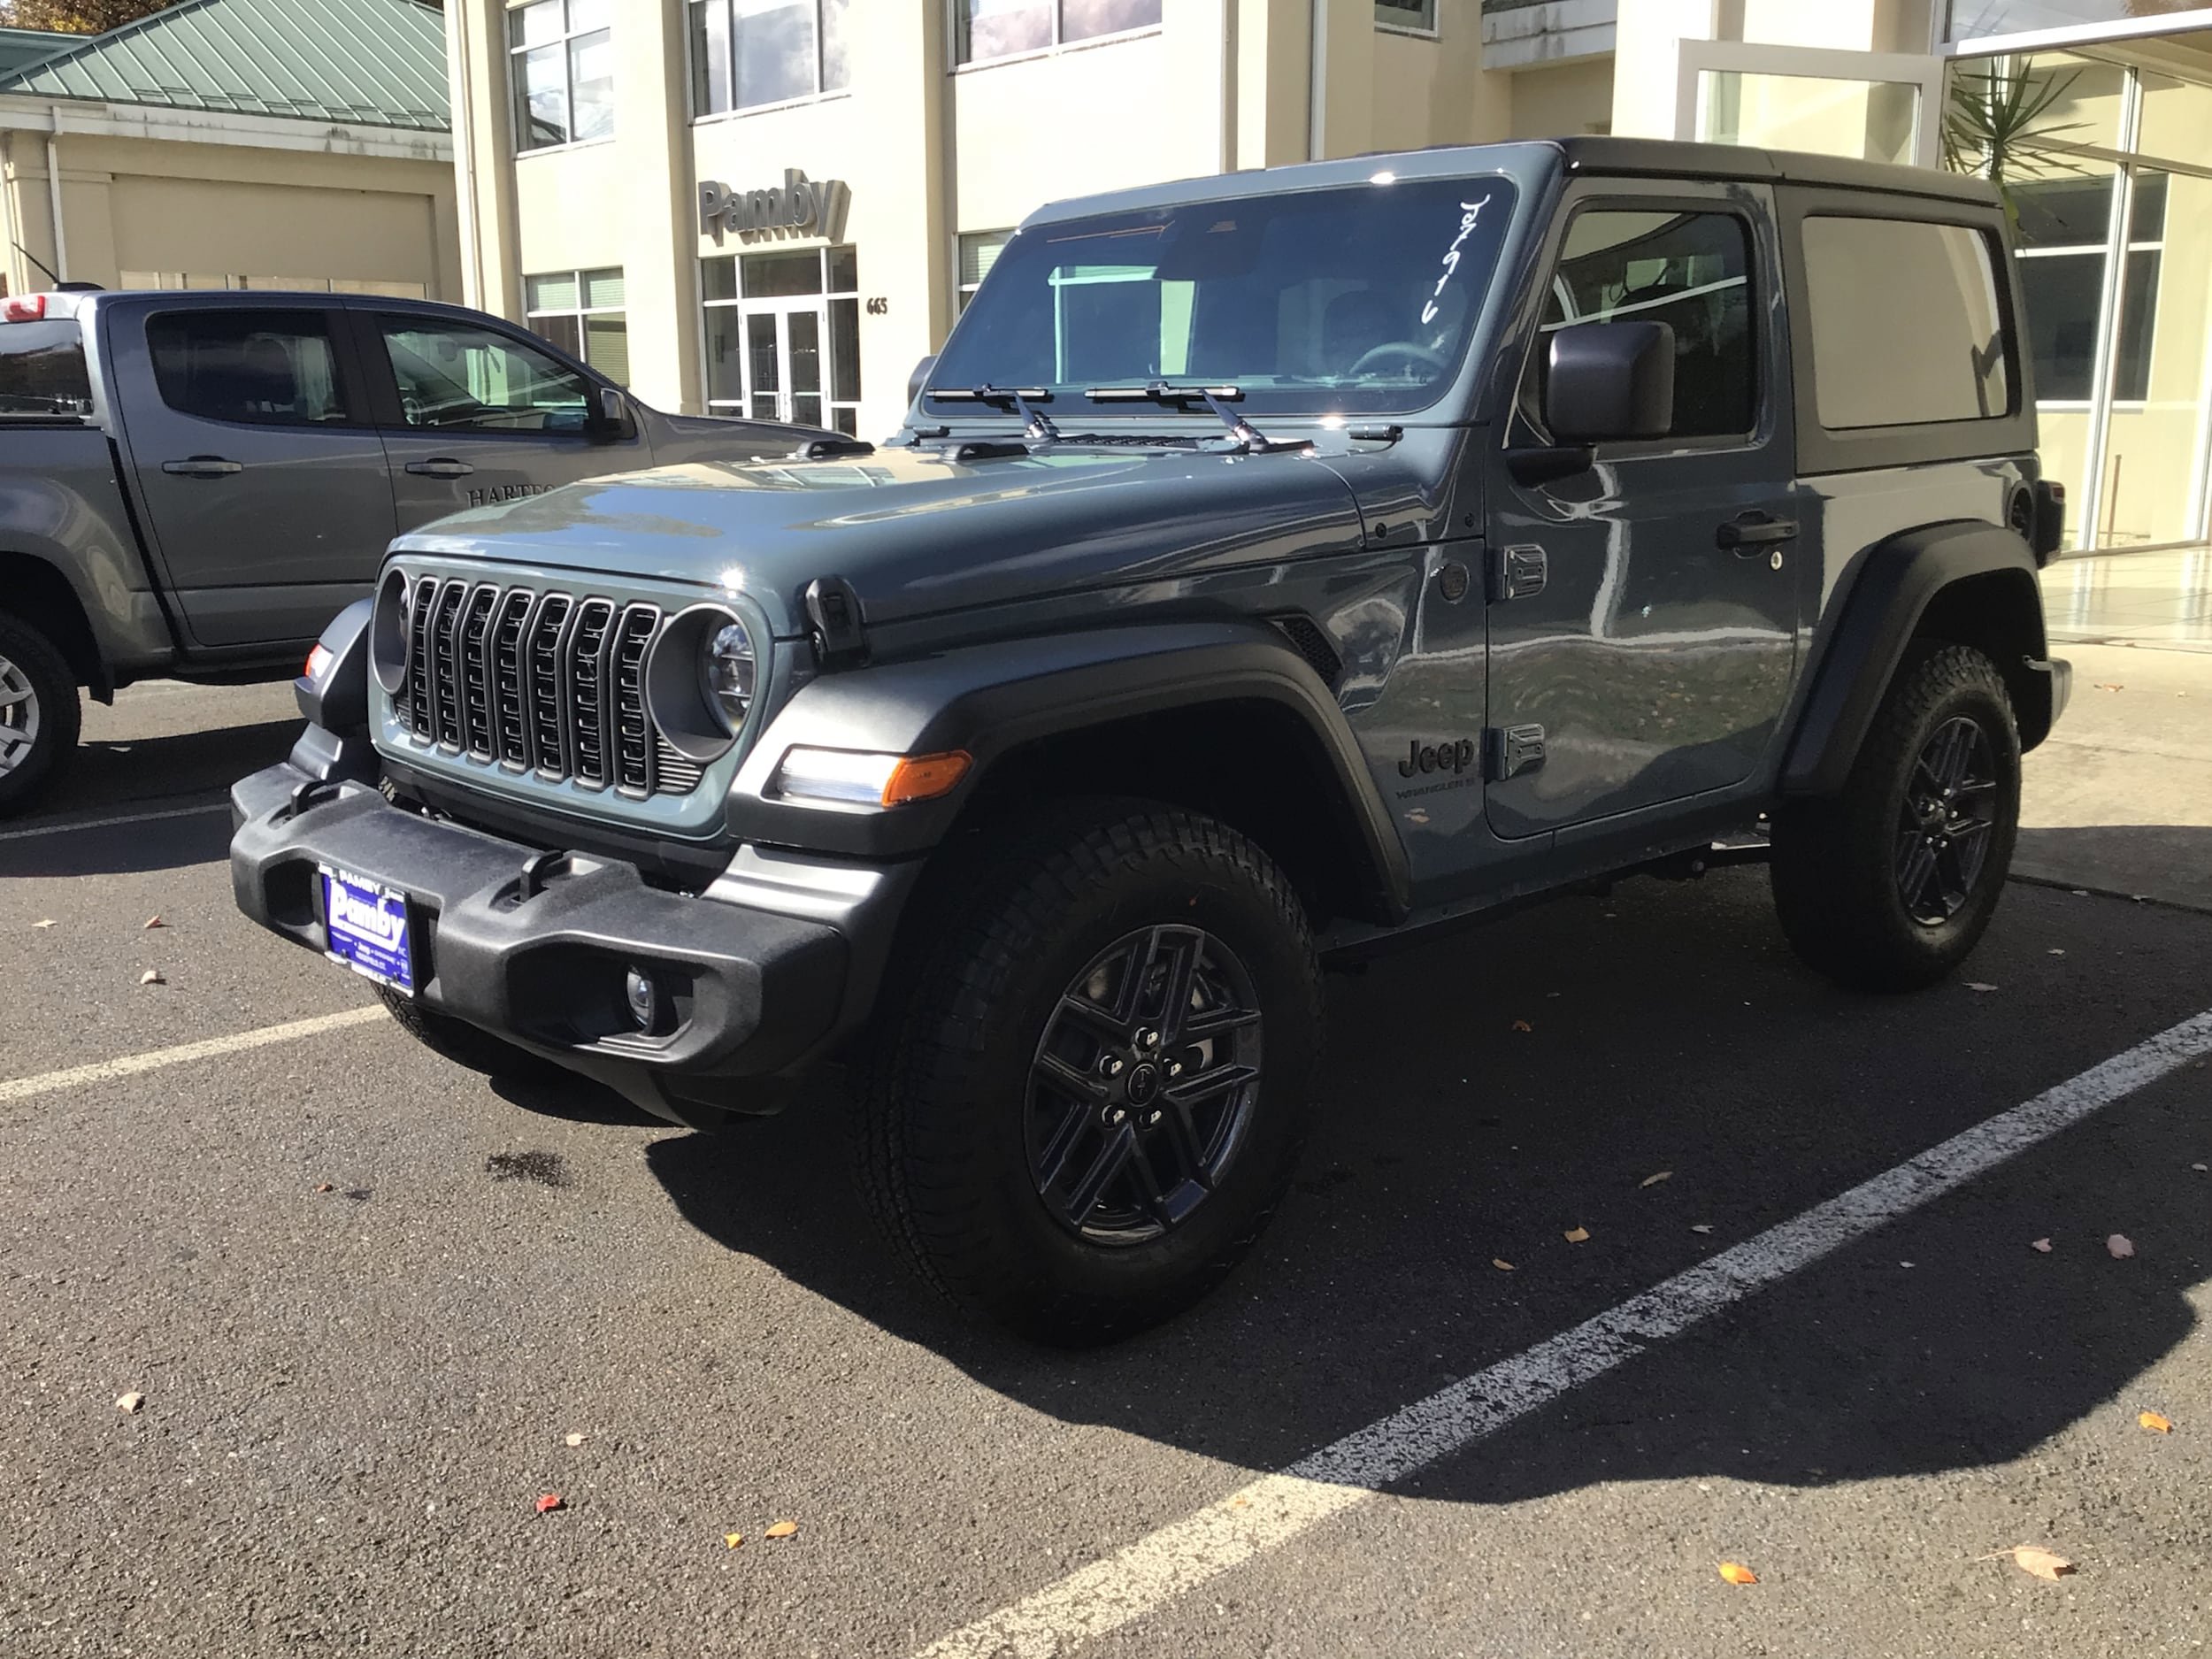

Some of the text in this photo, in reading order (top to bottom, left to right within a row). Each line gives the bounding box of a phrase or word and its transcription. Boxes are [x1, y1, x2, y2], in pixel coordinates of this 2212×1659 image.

[698, 168, 850, 244] Pamby
[866, 297, 887, 315] 665
[1398, 738, 1475, 778] Jeep
[1395, 780, 1464, 800] WRANGLER
[339, 869, 381, 895] PAMBY
[329, 879, 406, 952] Pamby
